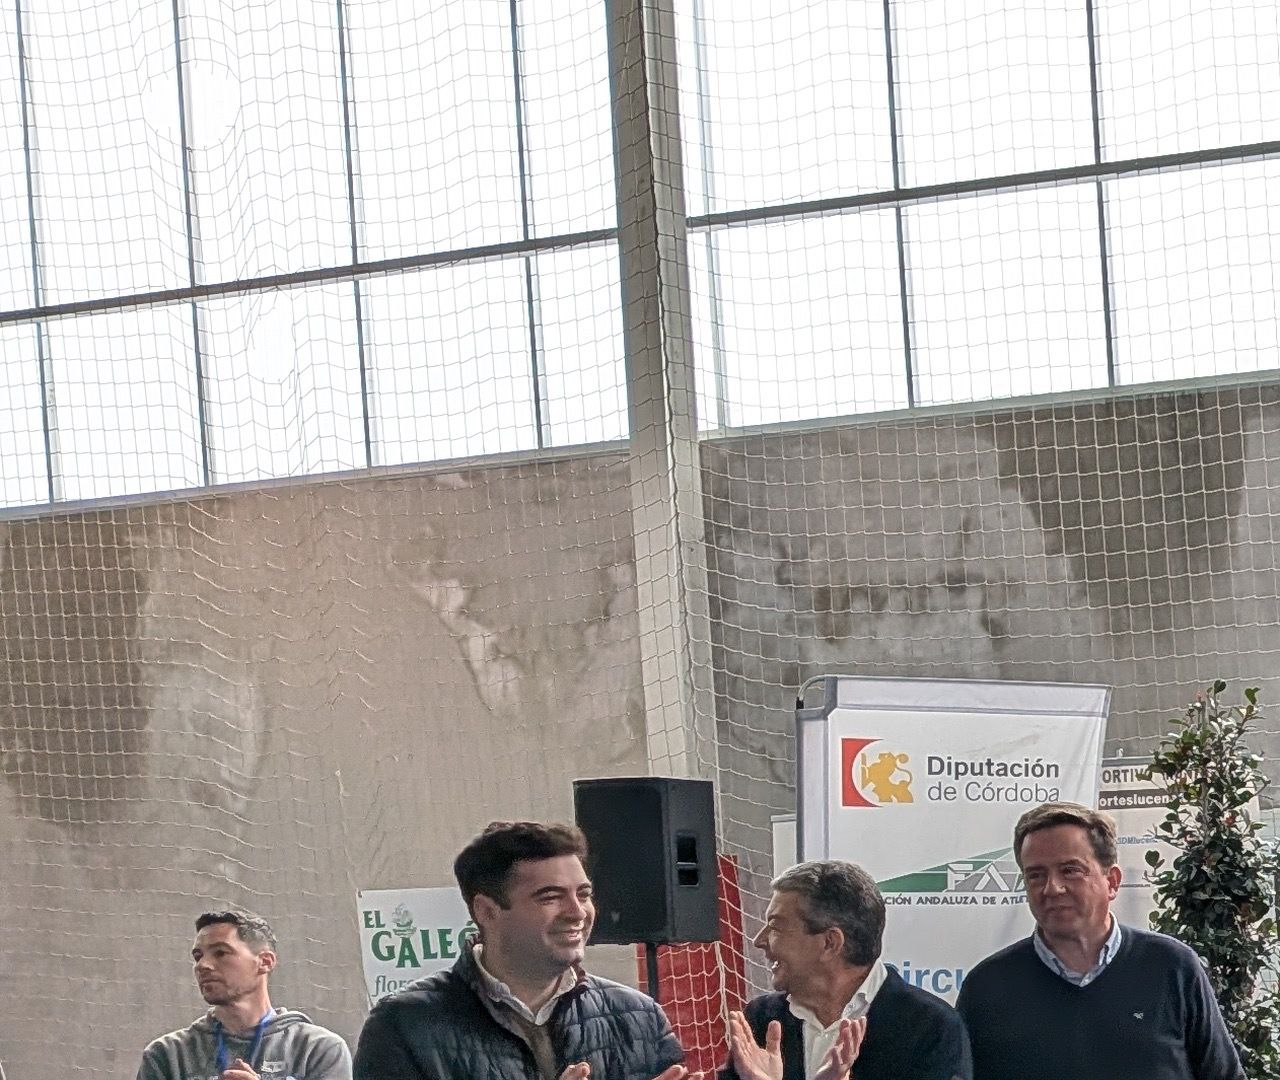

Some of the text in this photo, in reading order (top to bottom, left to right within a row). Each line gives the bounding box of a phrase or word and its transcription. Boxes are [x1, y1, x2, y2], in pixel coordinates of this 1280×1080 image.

[927, 754, 1060, 781] Diputación
[927, 779, 1060, 803] de Córdoba
[916, 896, 979, 905] ANDALUZA
[982, 896, 997, 905] DE
[363, 910, 386, 929] EL
